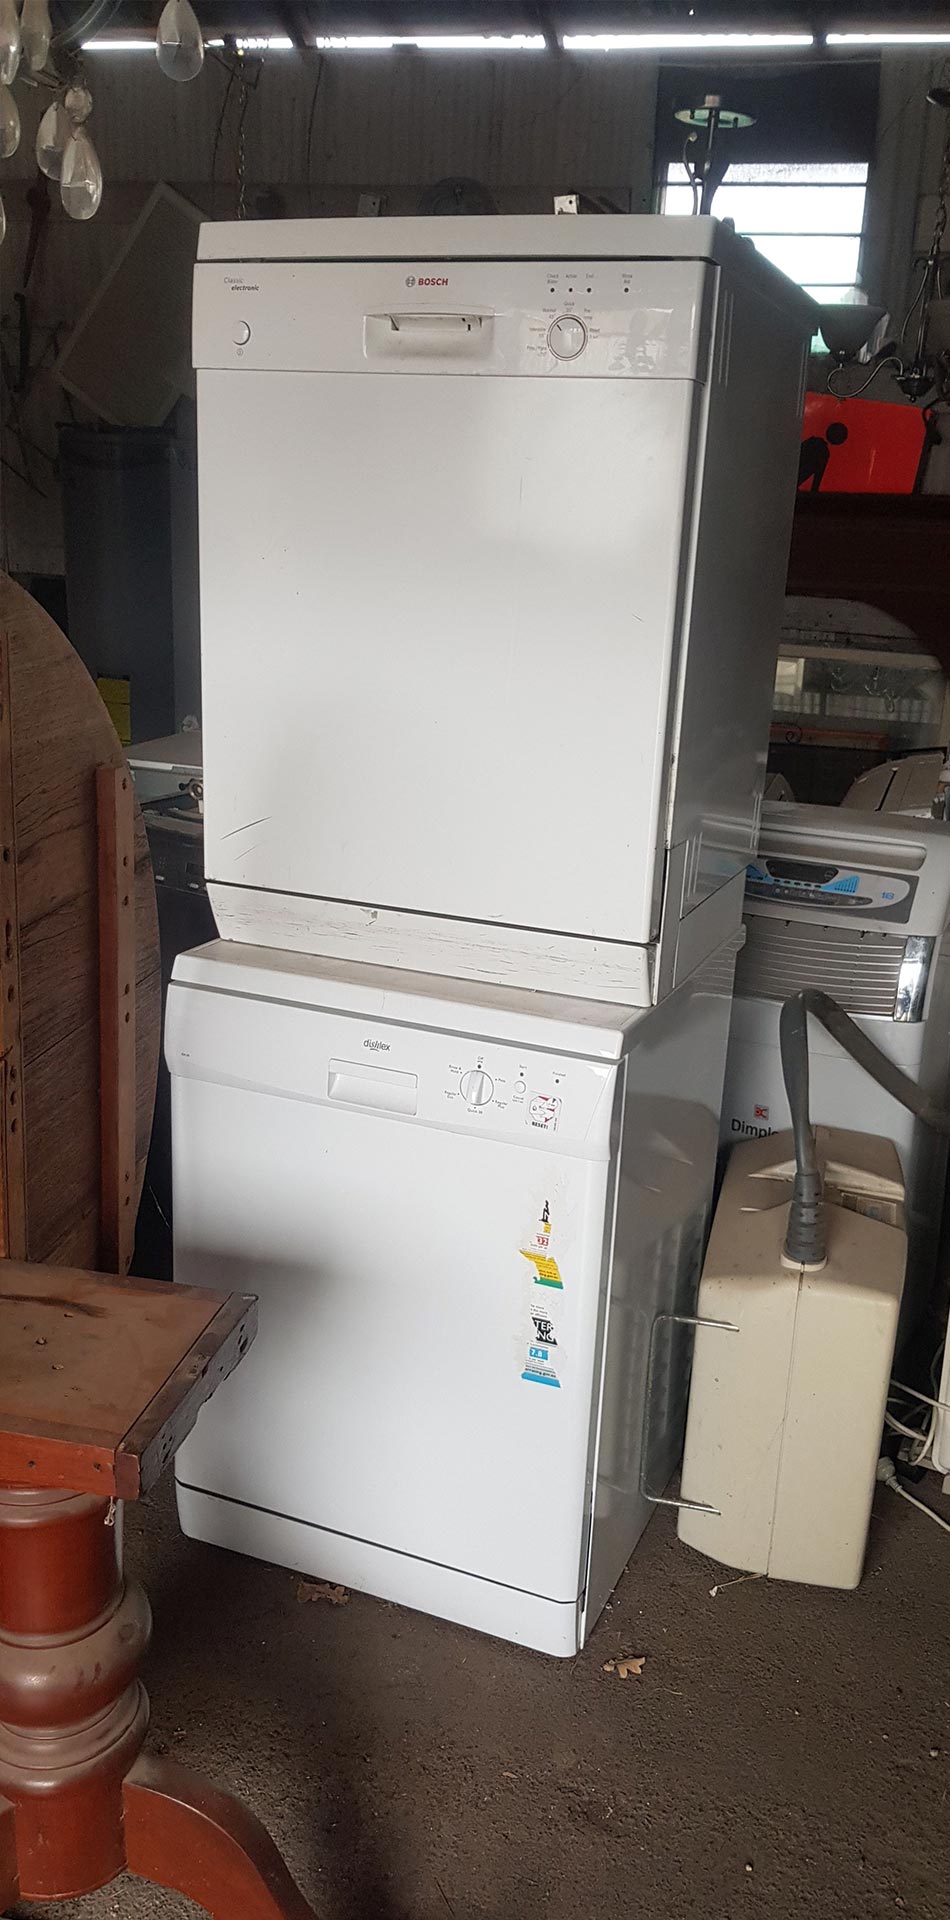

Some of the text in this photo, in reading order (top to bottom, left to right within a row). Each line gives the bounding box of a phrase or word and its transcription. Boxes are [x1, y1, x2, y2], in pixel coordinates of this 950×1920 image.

[417, 277, 449, 286] BOSCH
[363, 1039, 391, 1052] dishlex
[531, 1120, 549, 1130] RESET!
